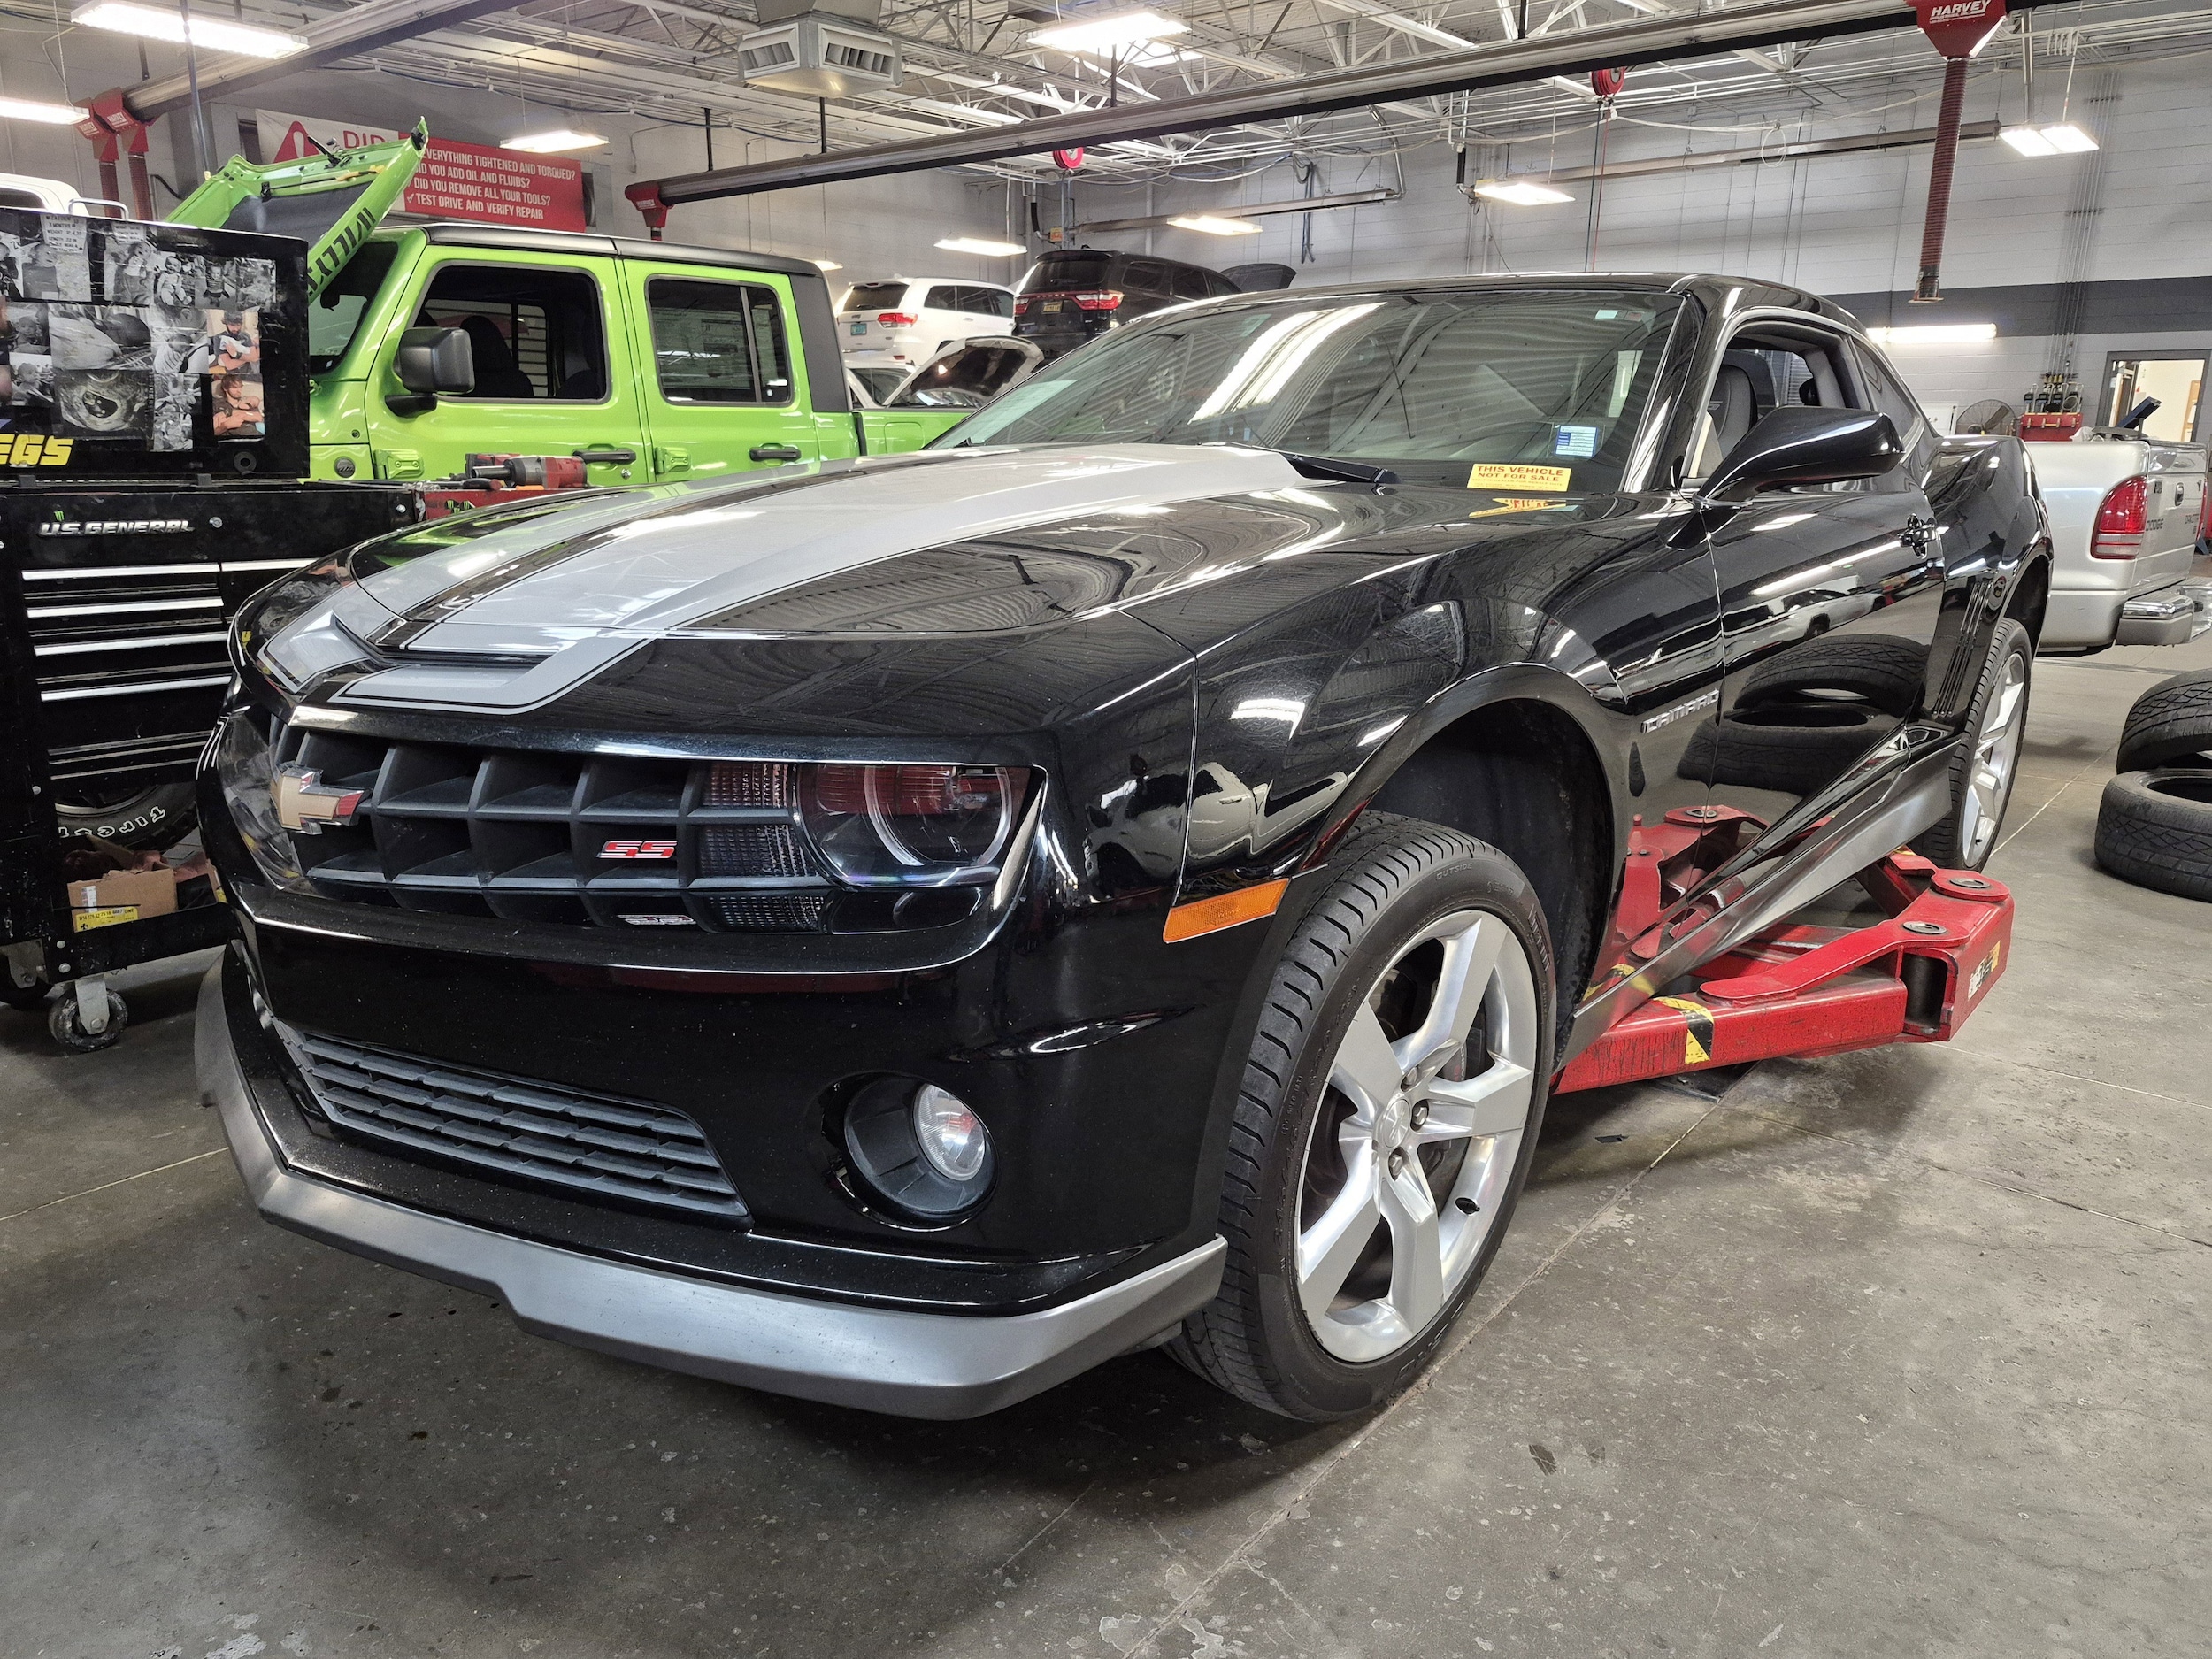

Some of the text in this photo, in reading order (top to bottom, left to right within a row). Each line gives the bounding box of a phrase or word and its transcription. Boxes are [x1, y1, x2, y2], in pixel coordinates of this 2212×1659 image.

[1931, 0, 1991, 17] HARVEY
[417, 162, 531, 188] ID YOU ADD OIL AND FLUIDS?
[422, 148, 576, 180] VERYTHING TIGHTENED AND TORQUED?
[414, 177, 551, 206] DID YOU REMOVE ALL YOUR TOOLS?
[416, 192, 544, 220] TEST DRIVE AND VERIFY REPAIR
[1509, 466, 1564, 476] VEHICLE
[83, 520, 195, 534] GENERAL
[1641, 688, 1719, 733] CAMARO
[596, 840, 678, 858] SS
[1436, 863, 1473, 880] OUTSIDE
